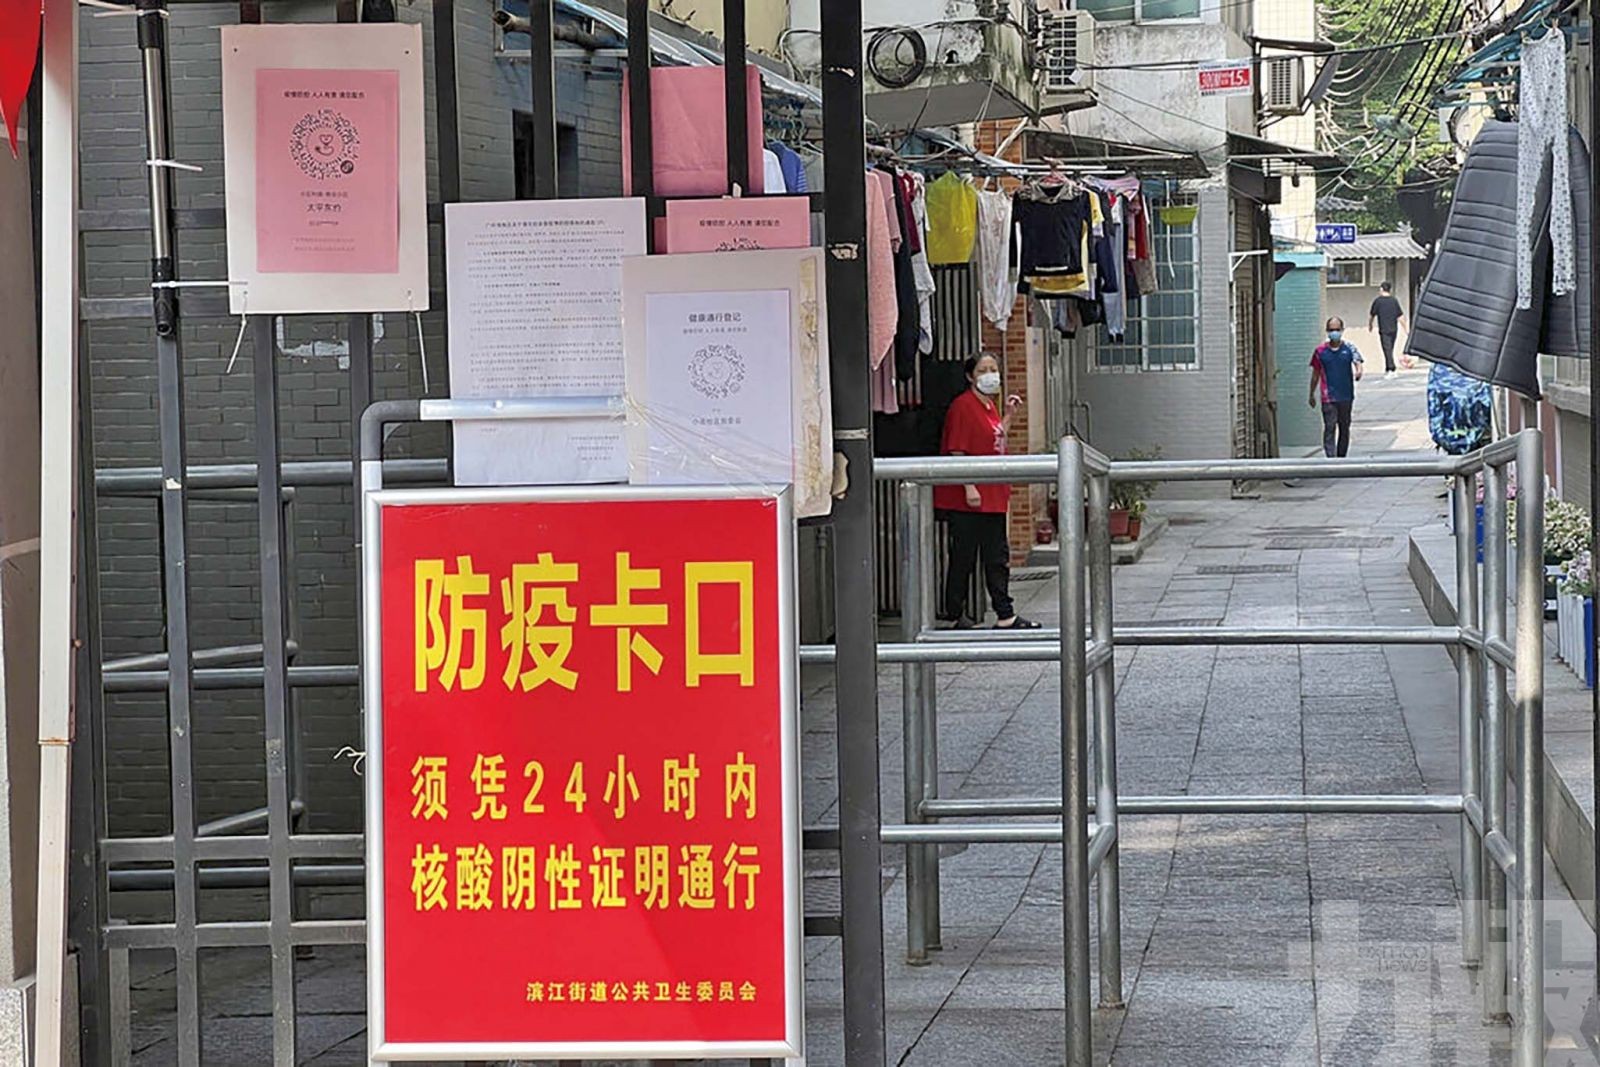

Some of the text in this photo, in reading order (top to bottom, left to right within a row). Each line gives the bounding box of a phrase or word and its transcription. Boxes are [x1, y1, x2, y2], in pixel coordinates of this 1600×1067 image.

[689, 312, 742, 323] 健康通行登记
[414, 552, 754, 692] 防疫卡口
[411, 752, 757, 820] 须凭24小时内
[411, 843, 761, 911] 核酸阴性证明通行
[526, 981, 757, 1002] 滨江街道公共卫生委员会
